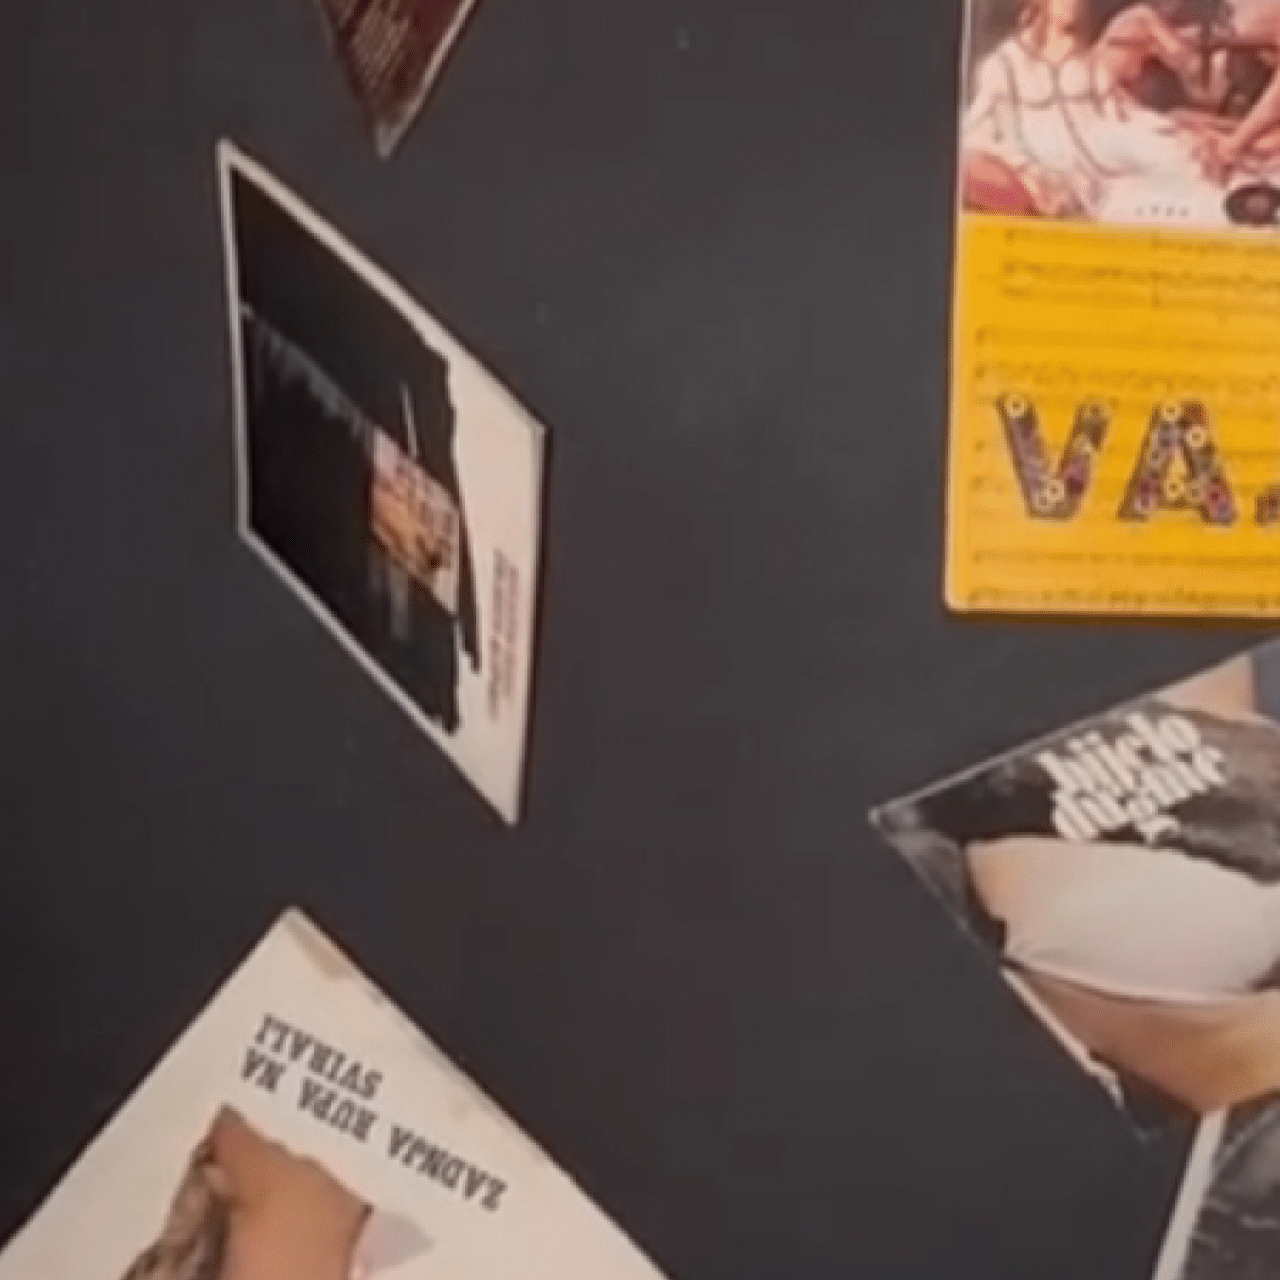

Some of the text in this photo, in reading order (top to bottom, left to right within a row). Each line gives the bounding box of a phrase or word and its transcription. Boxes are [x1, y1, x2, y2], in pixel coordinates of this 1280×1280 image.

[254, 1012, 383, 1100] SVIRALI
[240, 1046, 508, 1212] ZADNJA RUPA NA
